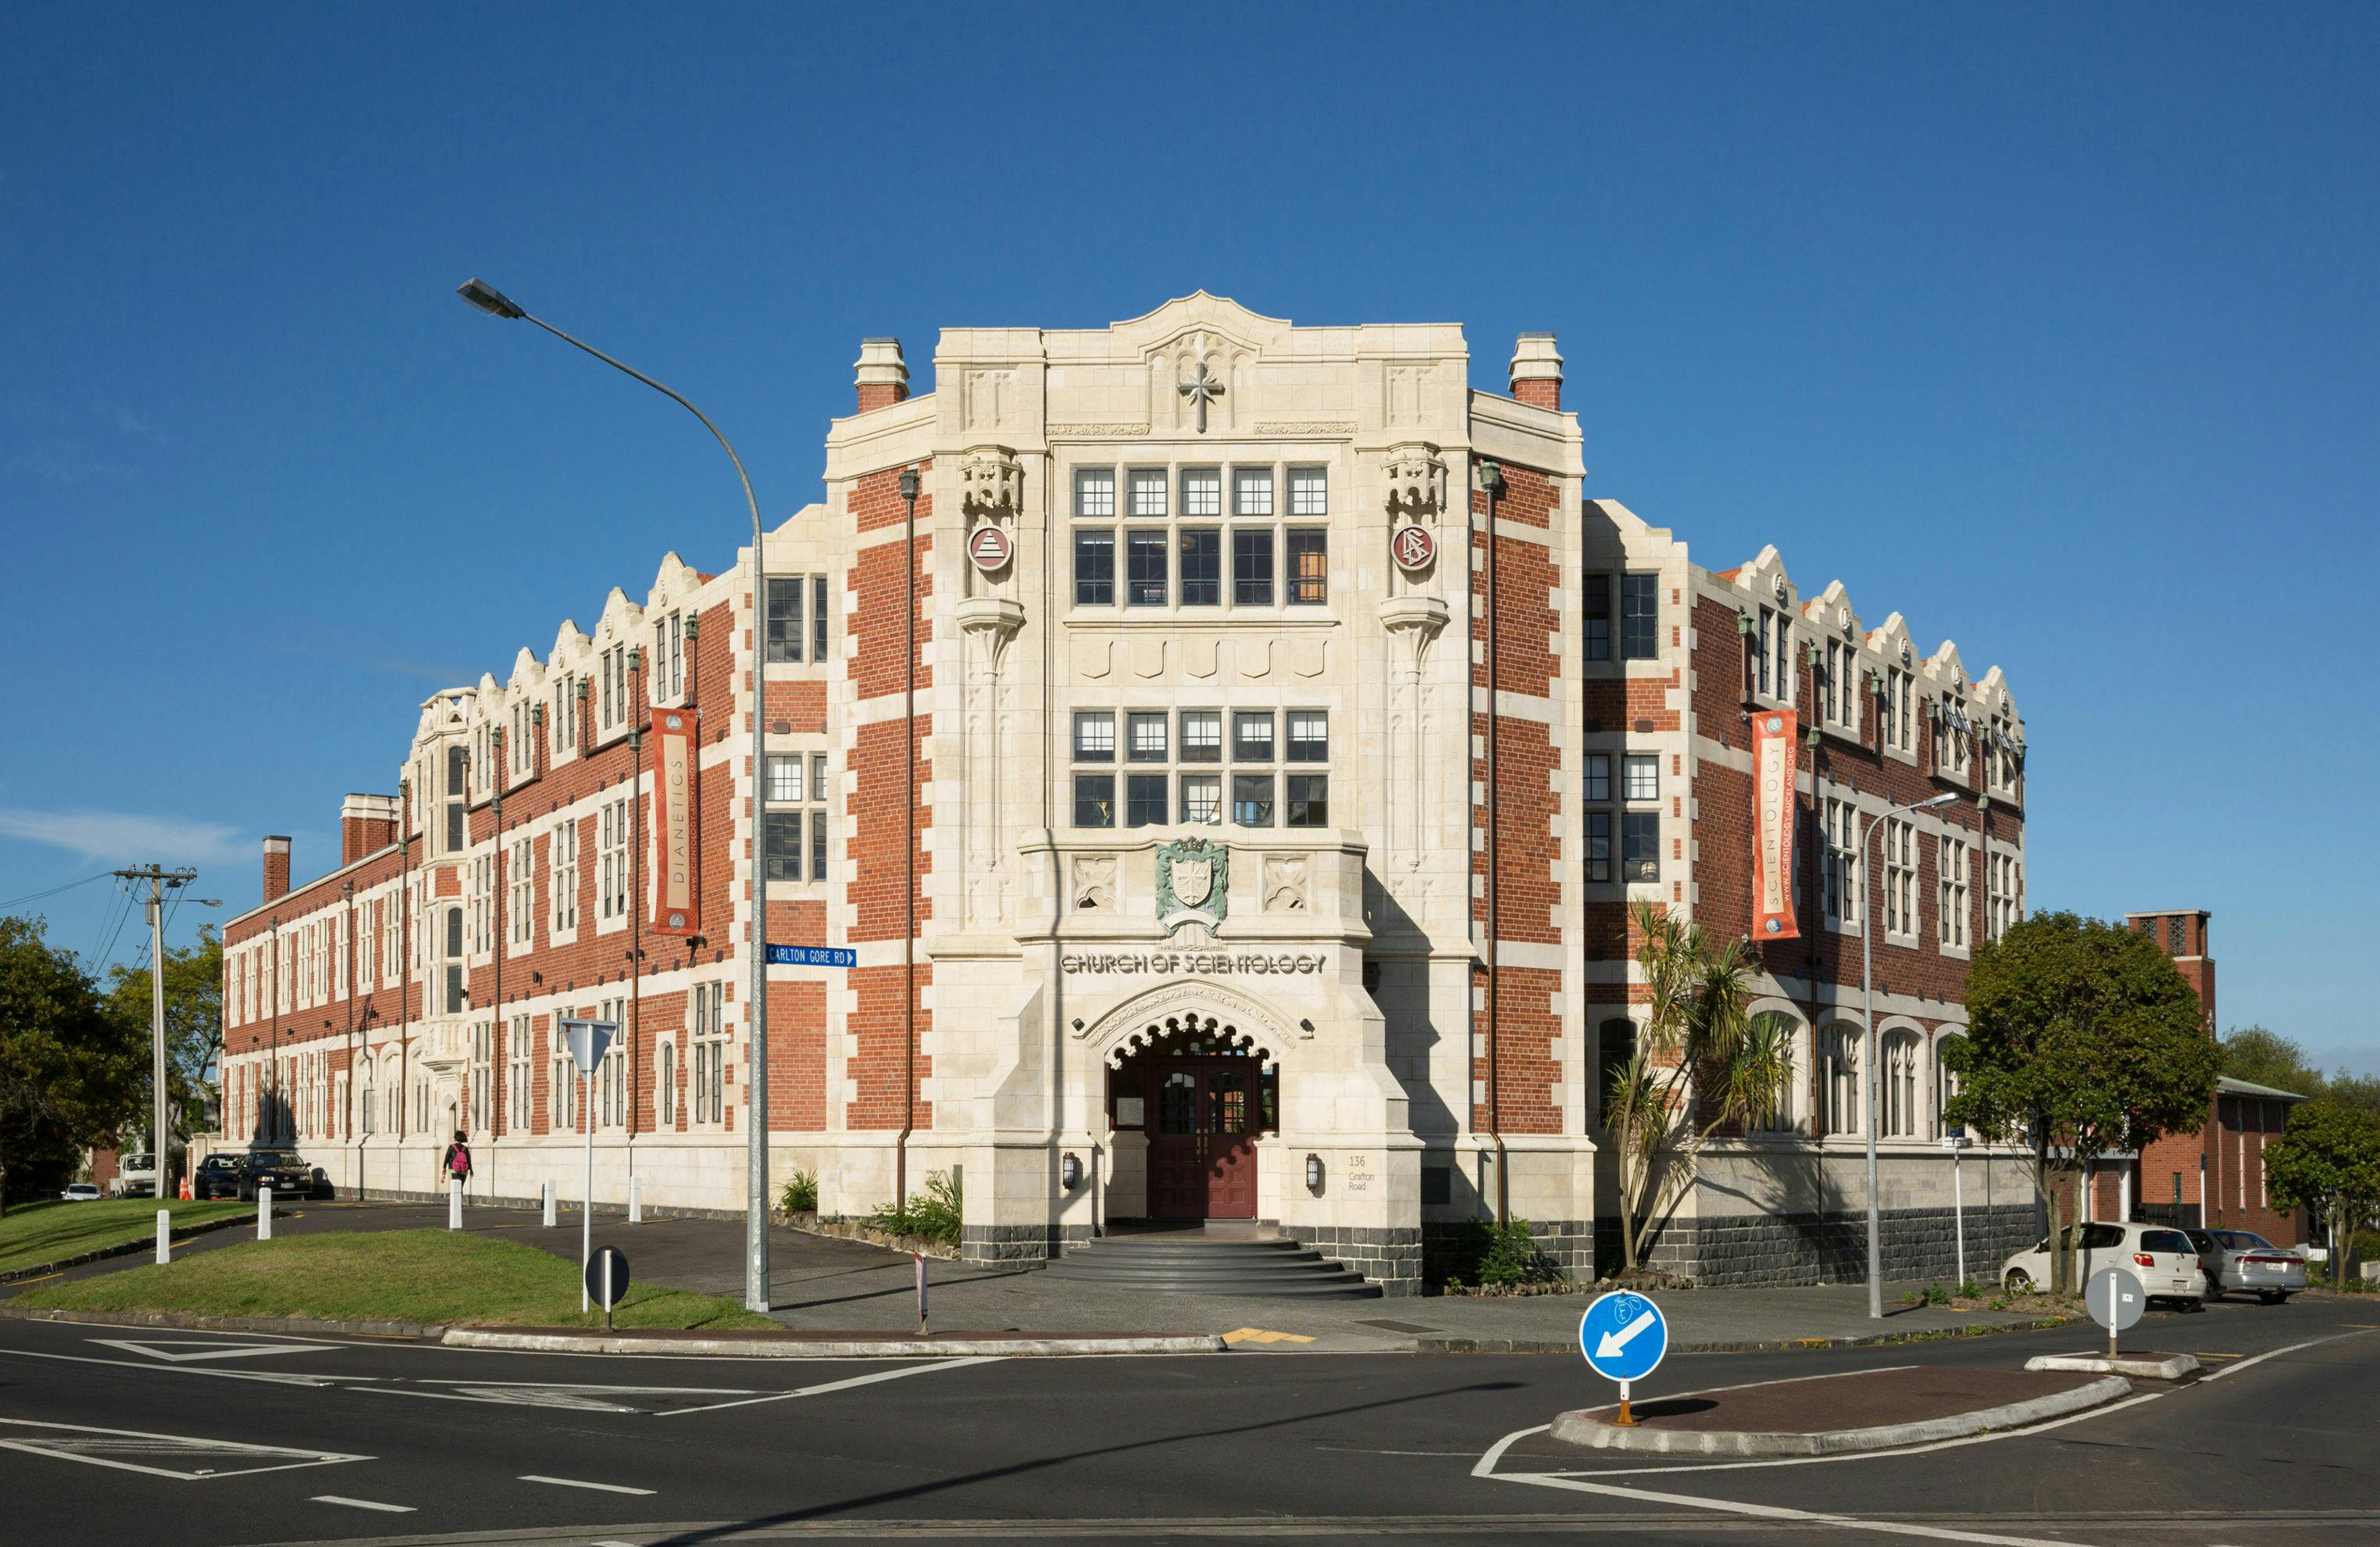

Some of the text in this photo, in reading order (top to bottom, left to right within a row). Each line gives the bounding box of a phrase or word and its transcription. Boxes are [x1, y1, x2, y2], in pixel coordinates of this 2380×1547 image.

[671, 760, 684, 884] DIANETICS
[1764, 748, 1779, 905] SCIENTOLOGY
[1782, 746, 1794, 902] WWW.SCIENTOLOGY-AUCKLAND.ORG
[769, 948, 844, 964] CARLTON GORE RD
[1061, 953, 1326, 974] CHURCH OF SCIENTOLOGY
[1350, 1156, 1365, 1167] 136
[1348, 1172, 1375, 1181] Grafton
[1348, 1182, 1366, 1191] Road
